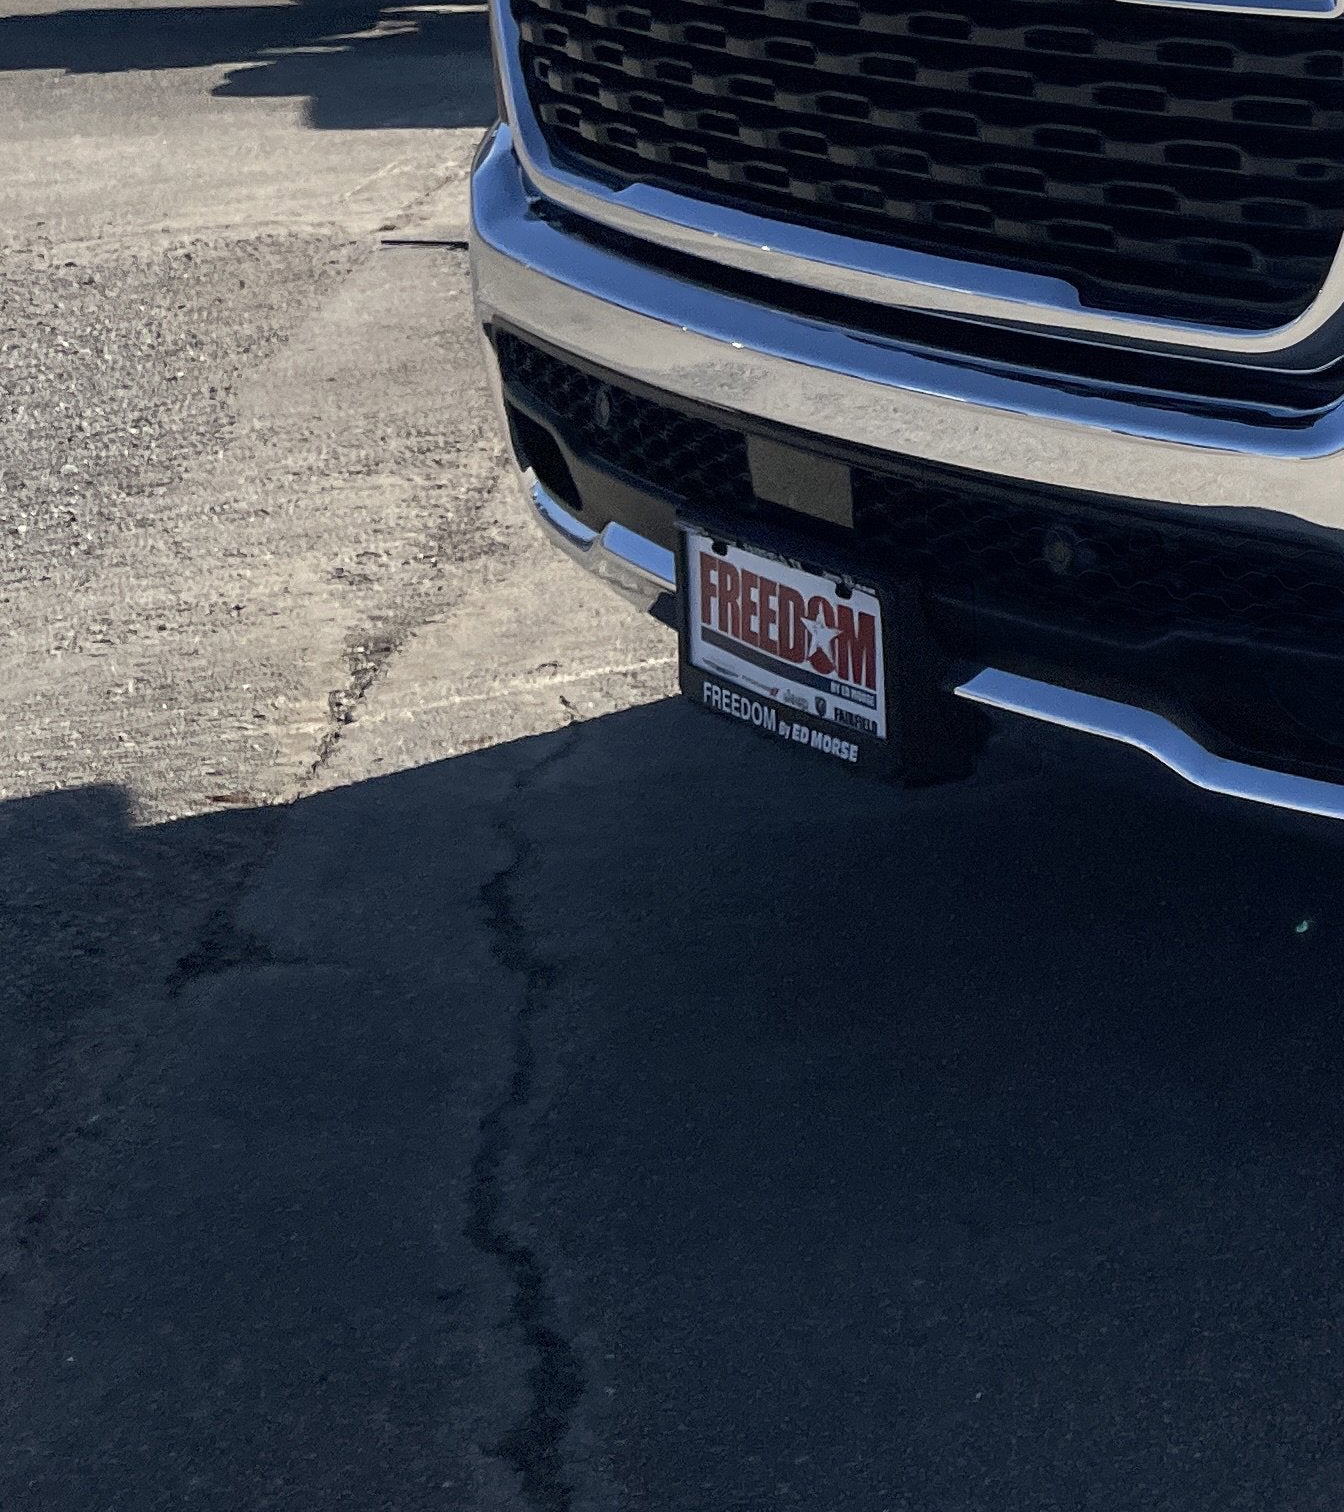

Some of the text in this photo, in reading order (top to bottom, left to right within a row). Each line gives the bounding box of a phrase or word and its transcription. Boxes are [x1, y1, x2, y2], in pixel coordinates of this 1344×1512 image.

[699, 551, 877, 690] FREEDOM
[703, 681, 777, 732] FREEDOM
[778, 721, 790, 739] by
[791, 729, 809, 745] ED
[810, 732, 859, 763] MORSE
